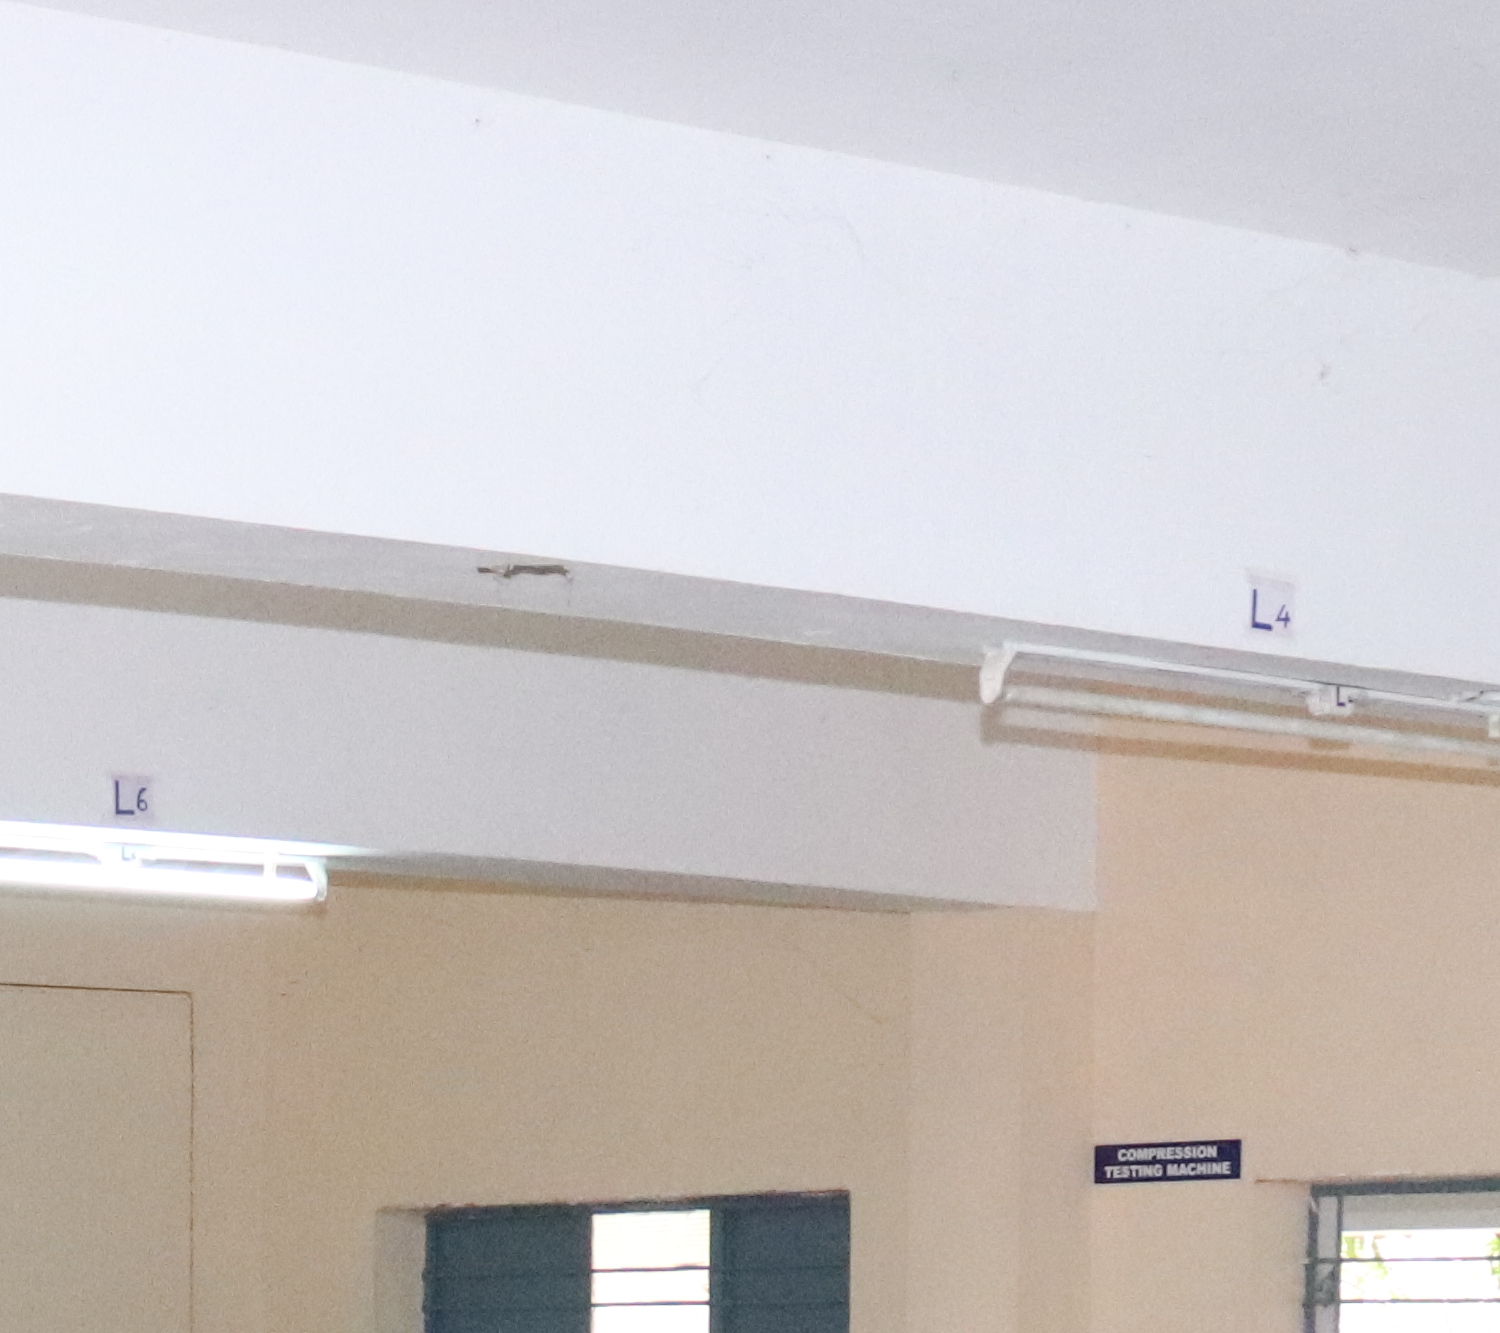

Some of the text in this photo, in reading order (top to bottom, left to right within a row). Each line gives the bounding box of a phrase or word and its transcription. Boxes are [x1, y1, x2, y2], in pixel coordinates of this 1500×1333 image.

[1251, 588, 1291, 631] L4
[114, 780, 148, 815] L6
[1117, 1145, 1218, 1161] COMPRESSION
[1104, 1161, 1232, 1179] TESTING MACHINE
